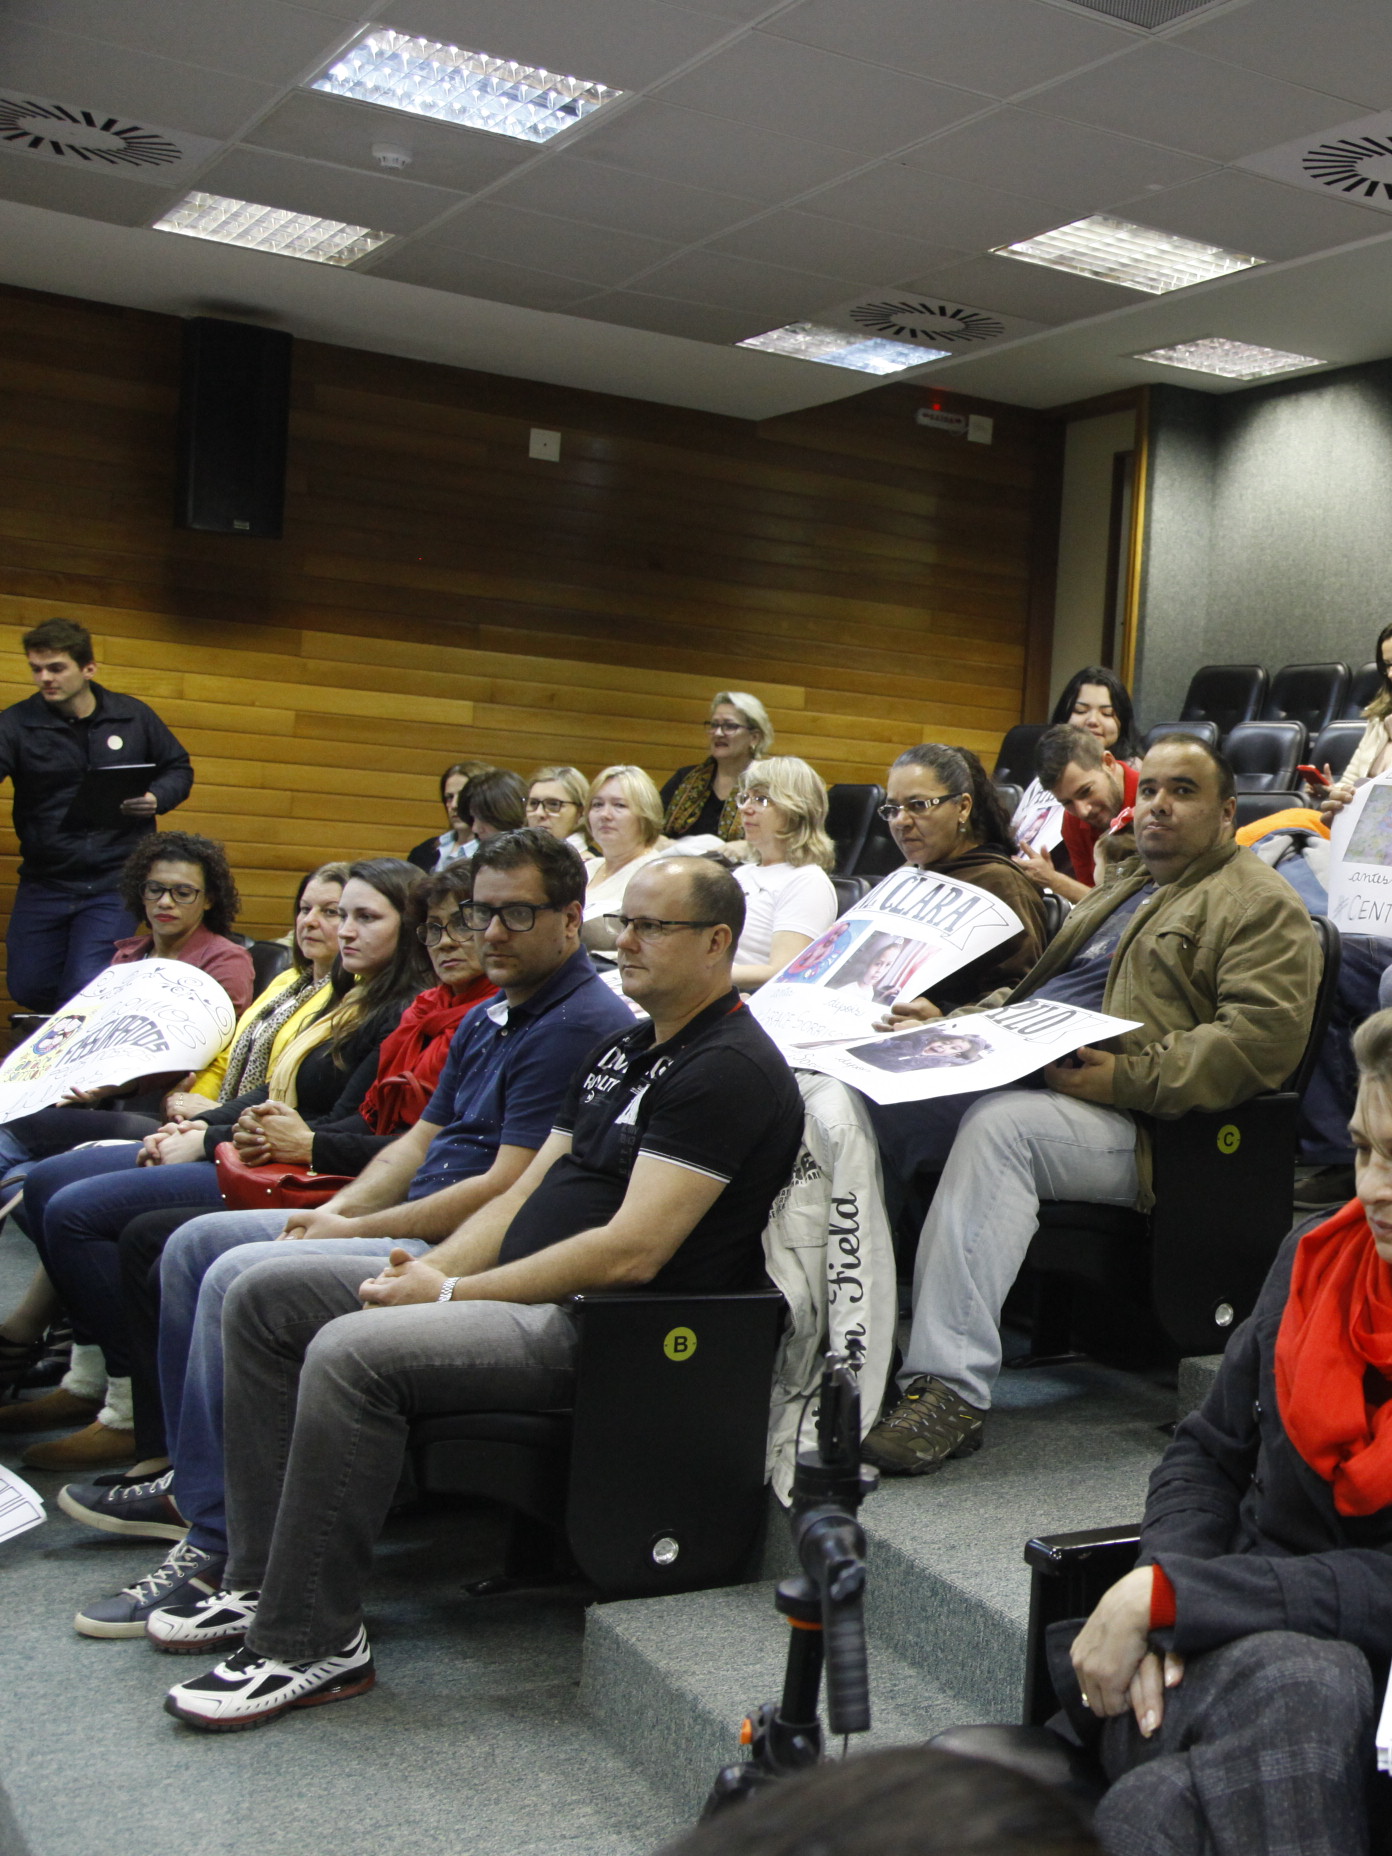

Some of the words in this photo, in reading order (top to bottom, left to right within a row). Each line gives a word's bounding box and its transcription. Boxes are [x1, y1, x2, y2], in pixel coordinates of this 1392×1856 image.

[1222, 1131, 1235, 1147] C
[826, 1191, 865, 1306] Field
[673, 1335, 689, 1354] B
